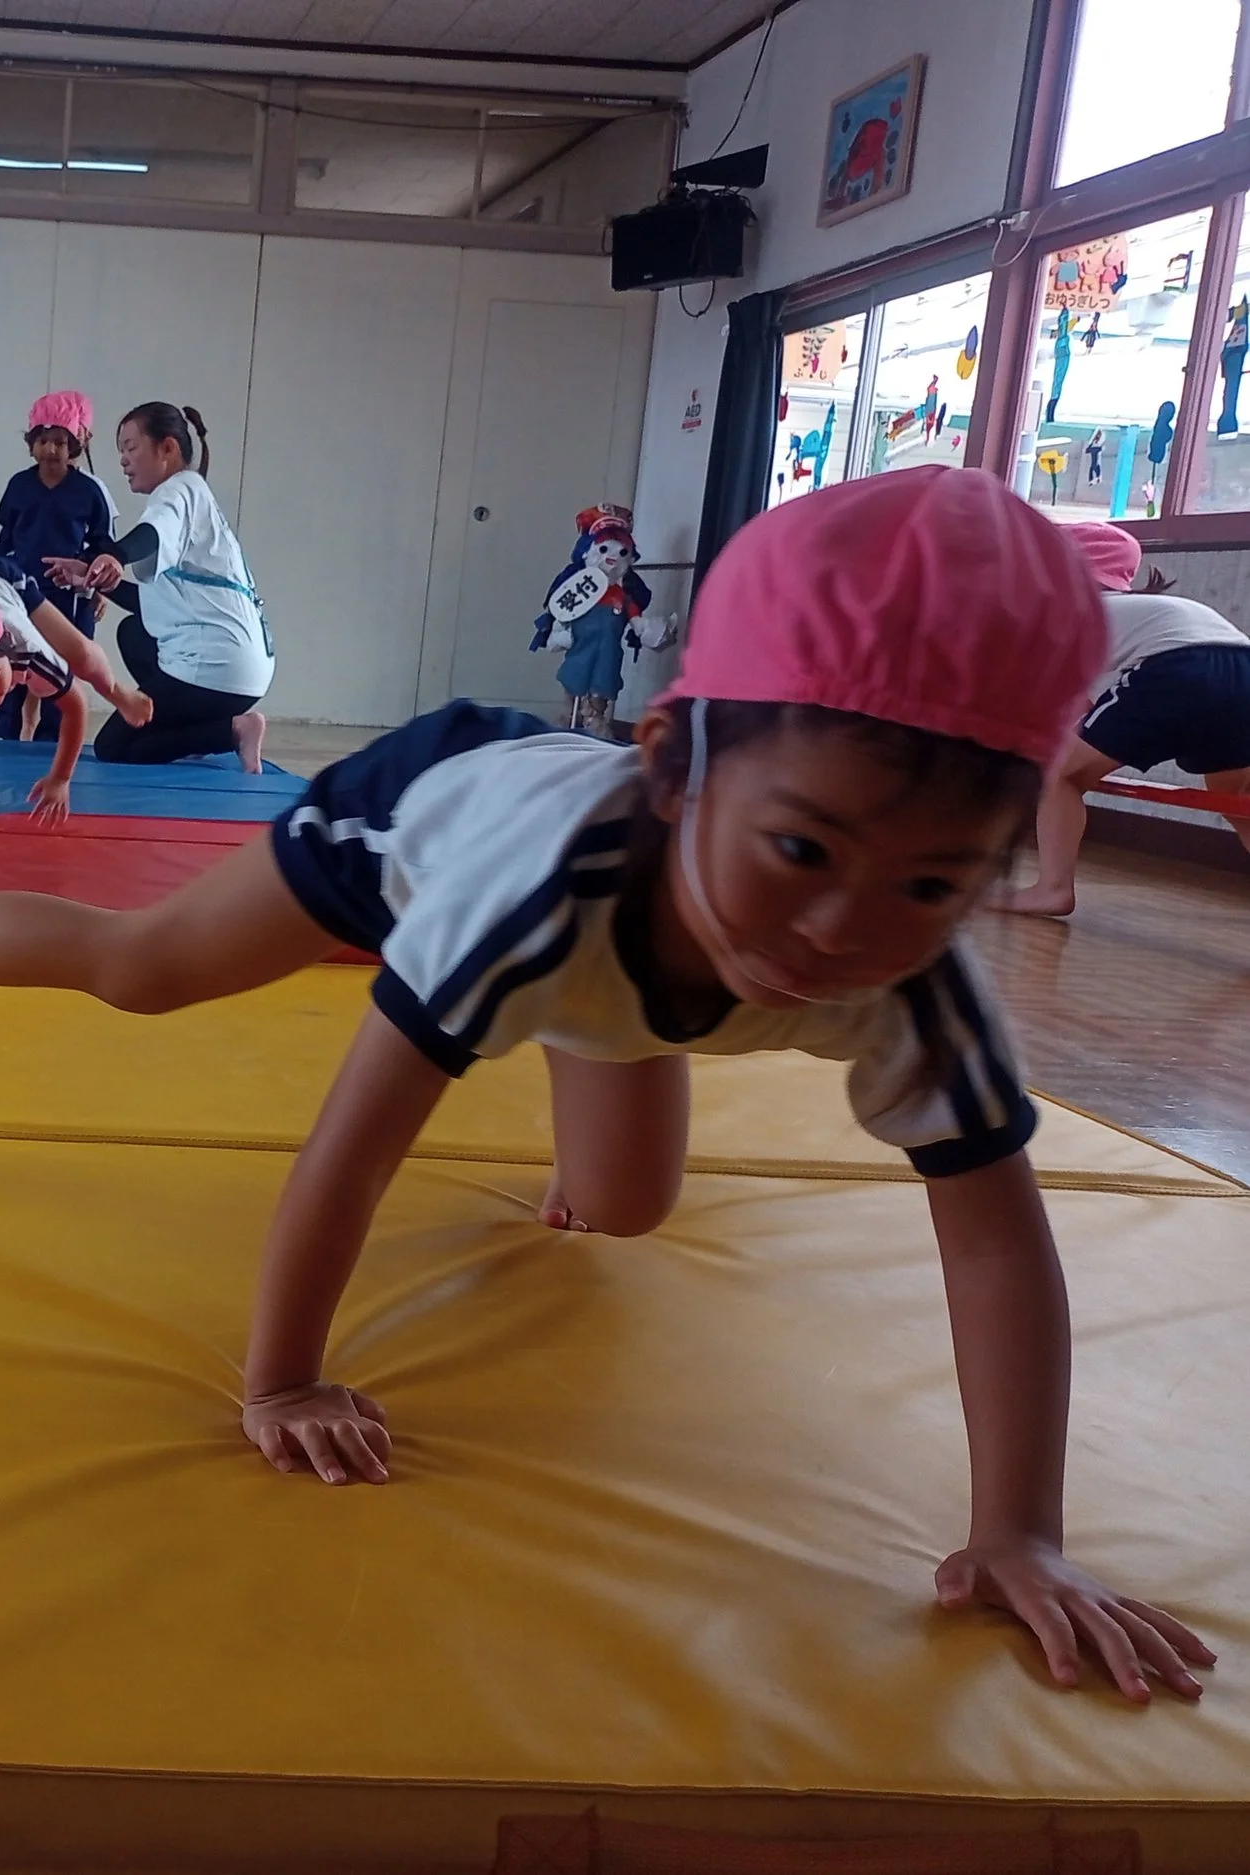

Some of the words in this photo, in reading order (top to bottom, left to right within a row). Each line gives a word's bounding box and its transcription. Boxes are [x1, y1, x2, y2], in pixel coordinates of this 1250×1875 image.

[1045, 292, 1110, 309] おゆうぎしつ
[684, 403, 702, 418] AED
[556, 574, 599, 613] 受付
